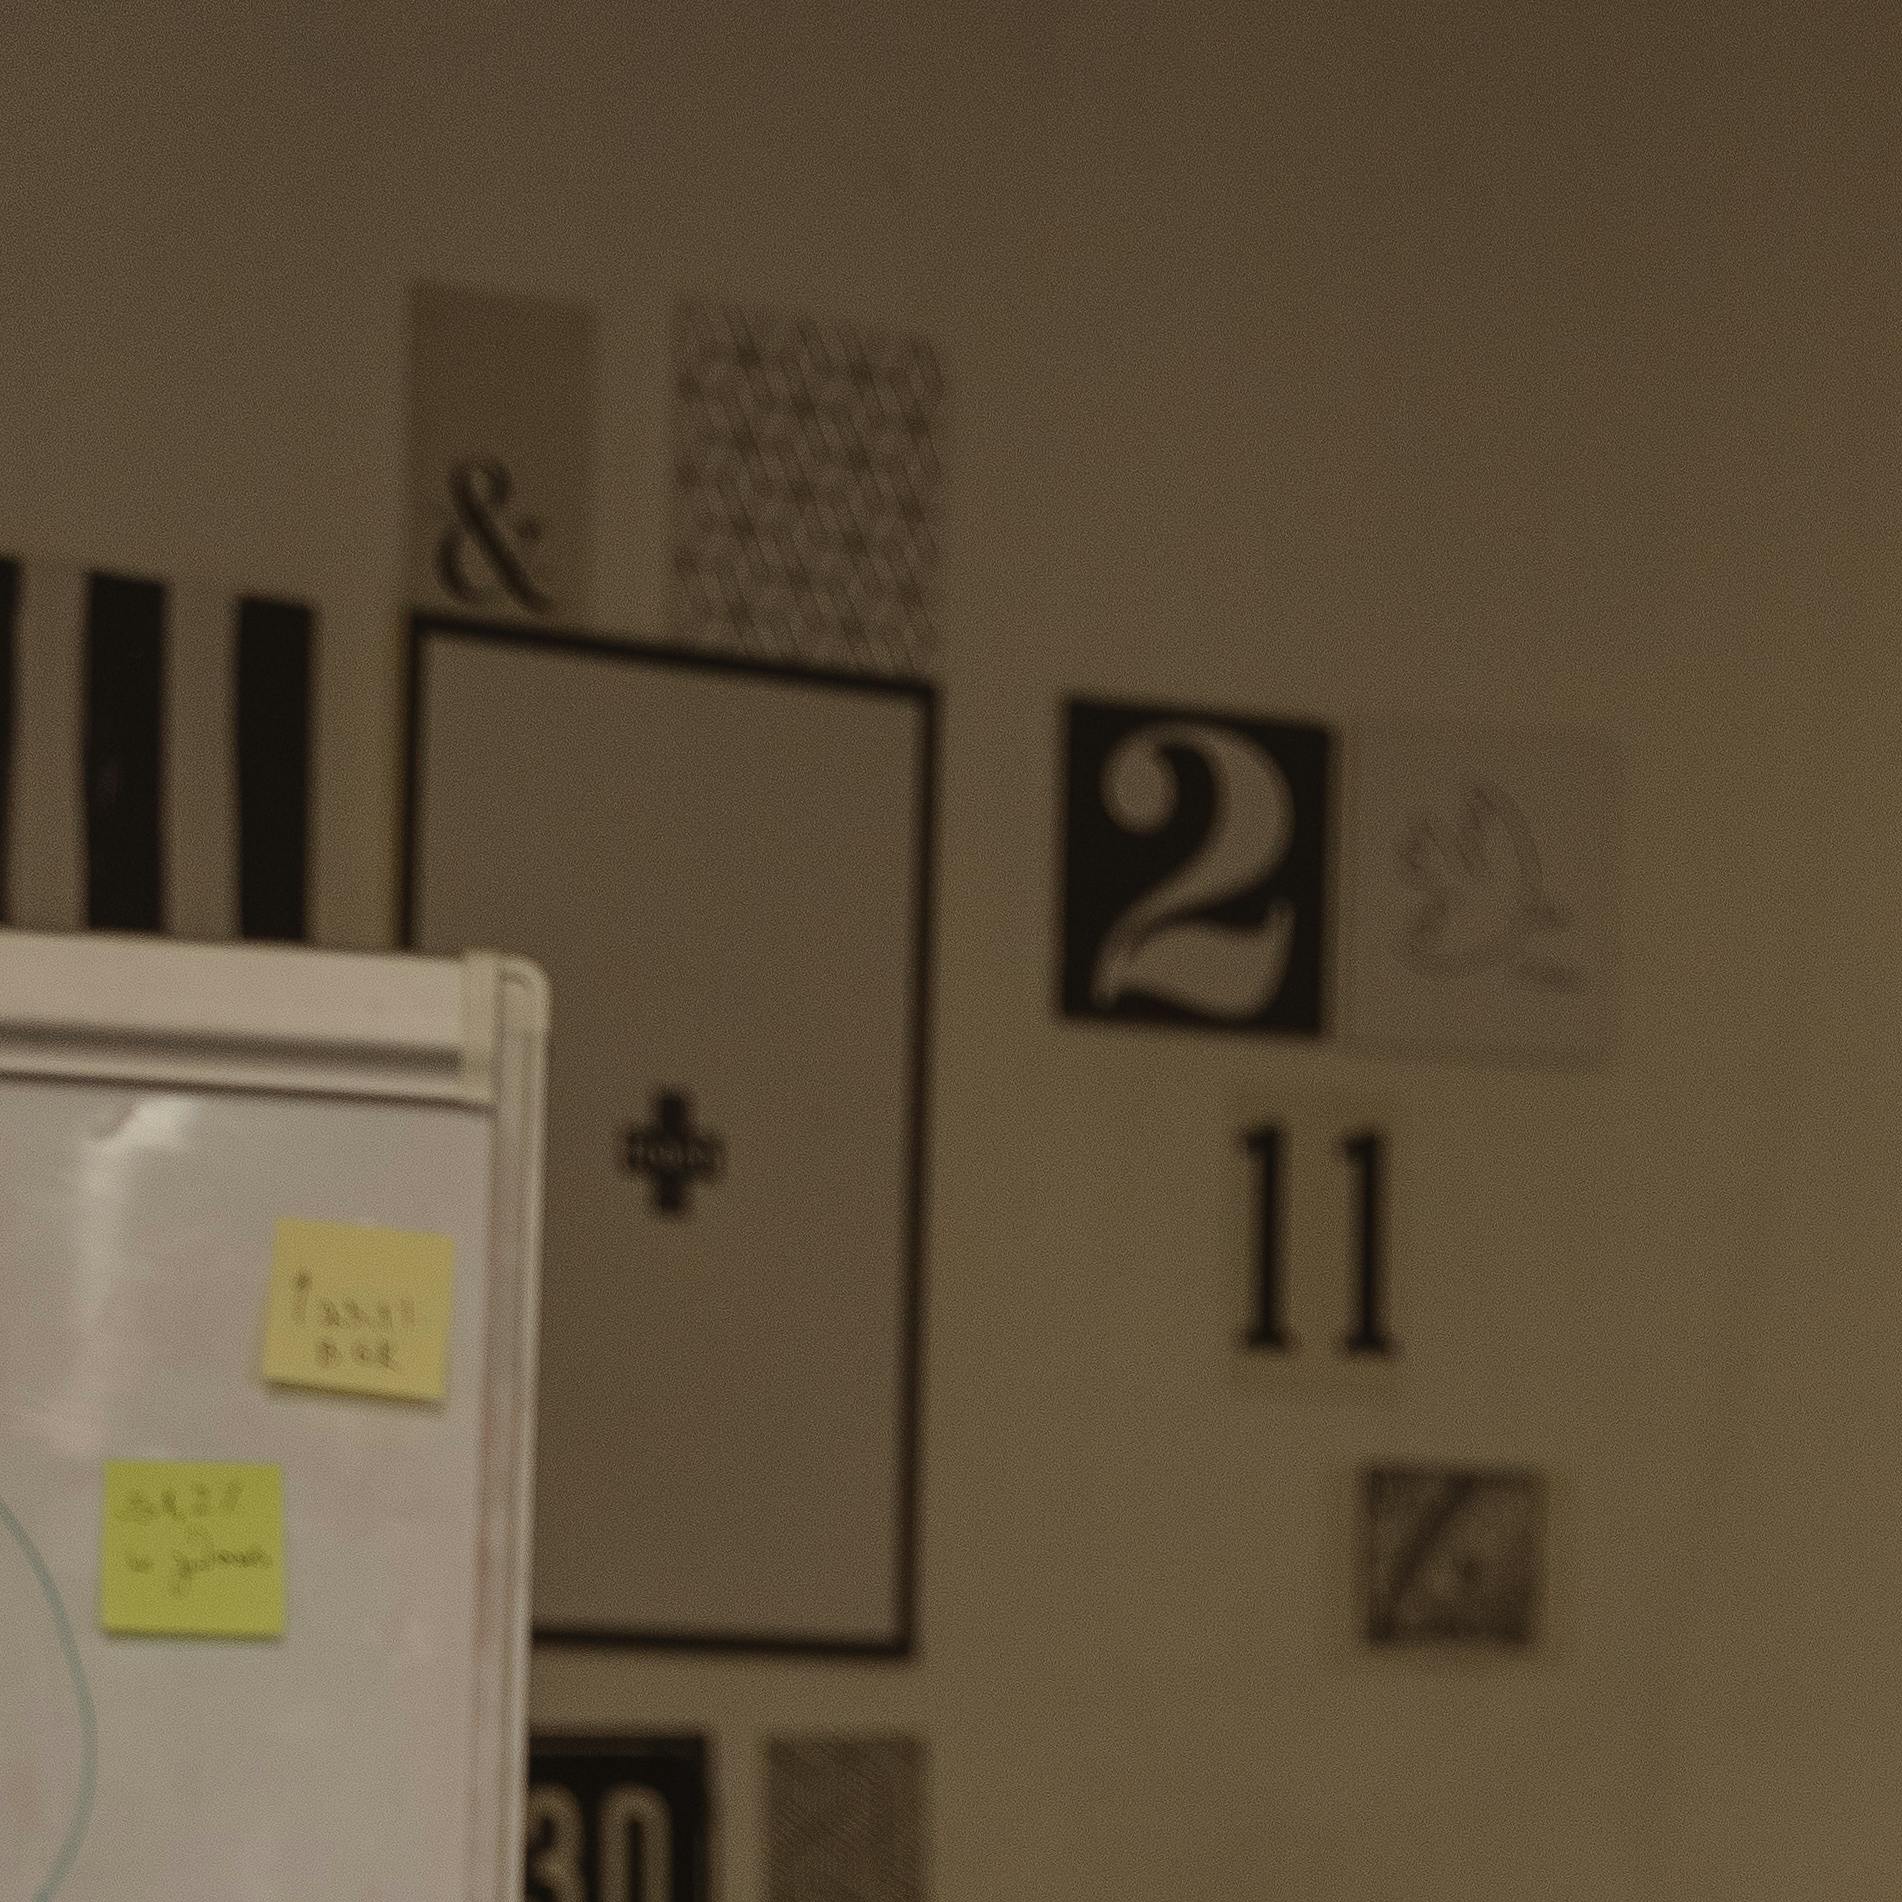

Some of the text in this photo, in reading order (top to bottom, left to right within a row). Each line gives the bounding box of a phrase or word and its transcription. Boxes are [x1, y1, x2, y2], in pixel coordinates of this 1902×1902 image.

[435, 456, 549, 613] &
[1088, 720, 1297, 1021] 2
[1235, 1120, 1397, 1356] 11
